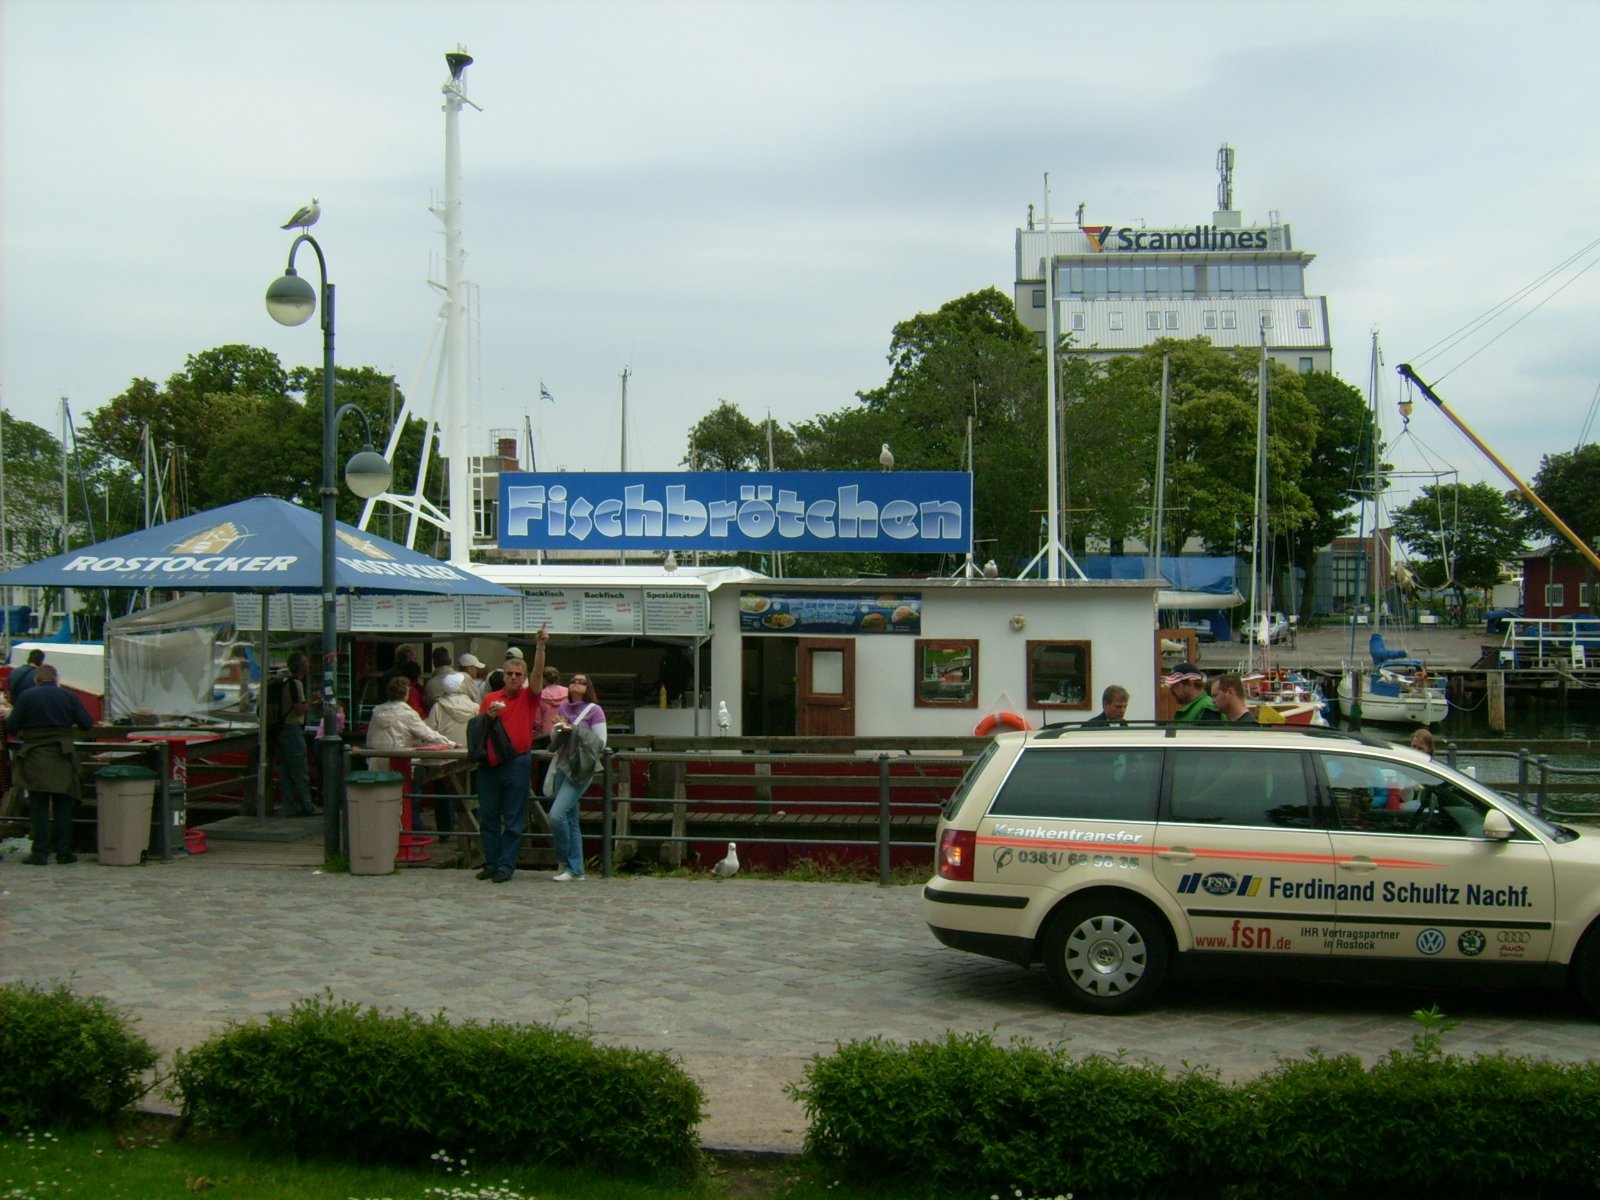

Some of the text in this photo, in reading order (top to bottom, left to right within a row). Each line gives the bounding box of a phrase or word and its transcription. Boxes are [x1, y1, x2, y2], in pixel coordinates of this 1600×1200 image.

[1117, 224, 1268, 251] Scandlines
[507, 484, 962, 541] Fischbrötchen
[63, 556, 297, 571] ROSTOCKER
[525, 590, 565, 598] Backfisch
[584, 591, 625, 599] Backfisch
[646, 591, 702, 600] Spezialitäten
[993, 824, 1143, 843] Krankentransfer
[1207, 876, 1233, 889] FSN
[1269, 877, 1533, 908] Ferdinand Schultz Nachf.
[1196, 919, 1291, 950] www.fsn.de
[1301, 927, 1400, 941] IHR Vertragspartner
[1324, 939, 1375, 950] in Rostock
